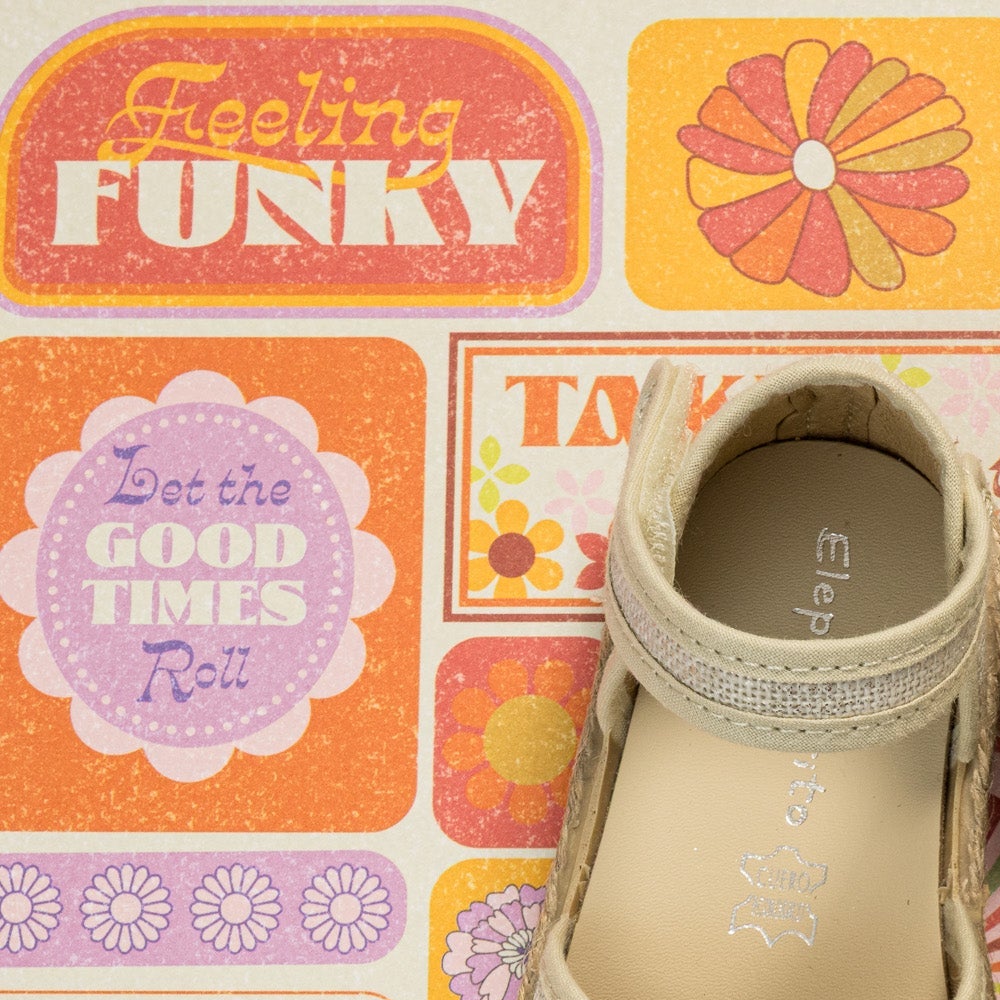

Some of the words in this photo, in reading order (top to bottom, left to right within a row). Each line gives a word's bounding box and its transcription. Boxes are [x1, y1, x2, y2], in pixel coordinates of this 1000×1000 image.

[97, 61, 464, 190] Feeling
[50, 160, 546, 248] FUNKY
[505, 375, 766, 446] TAK
[103, 444, 214, 506] Let
[217, 464, 291, 506] the
[85, 522, 307, 569] GOOD
[82, 579, 307, 626] TIMES
[137, 639, 251, 703] Roll
